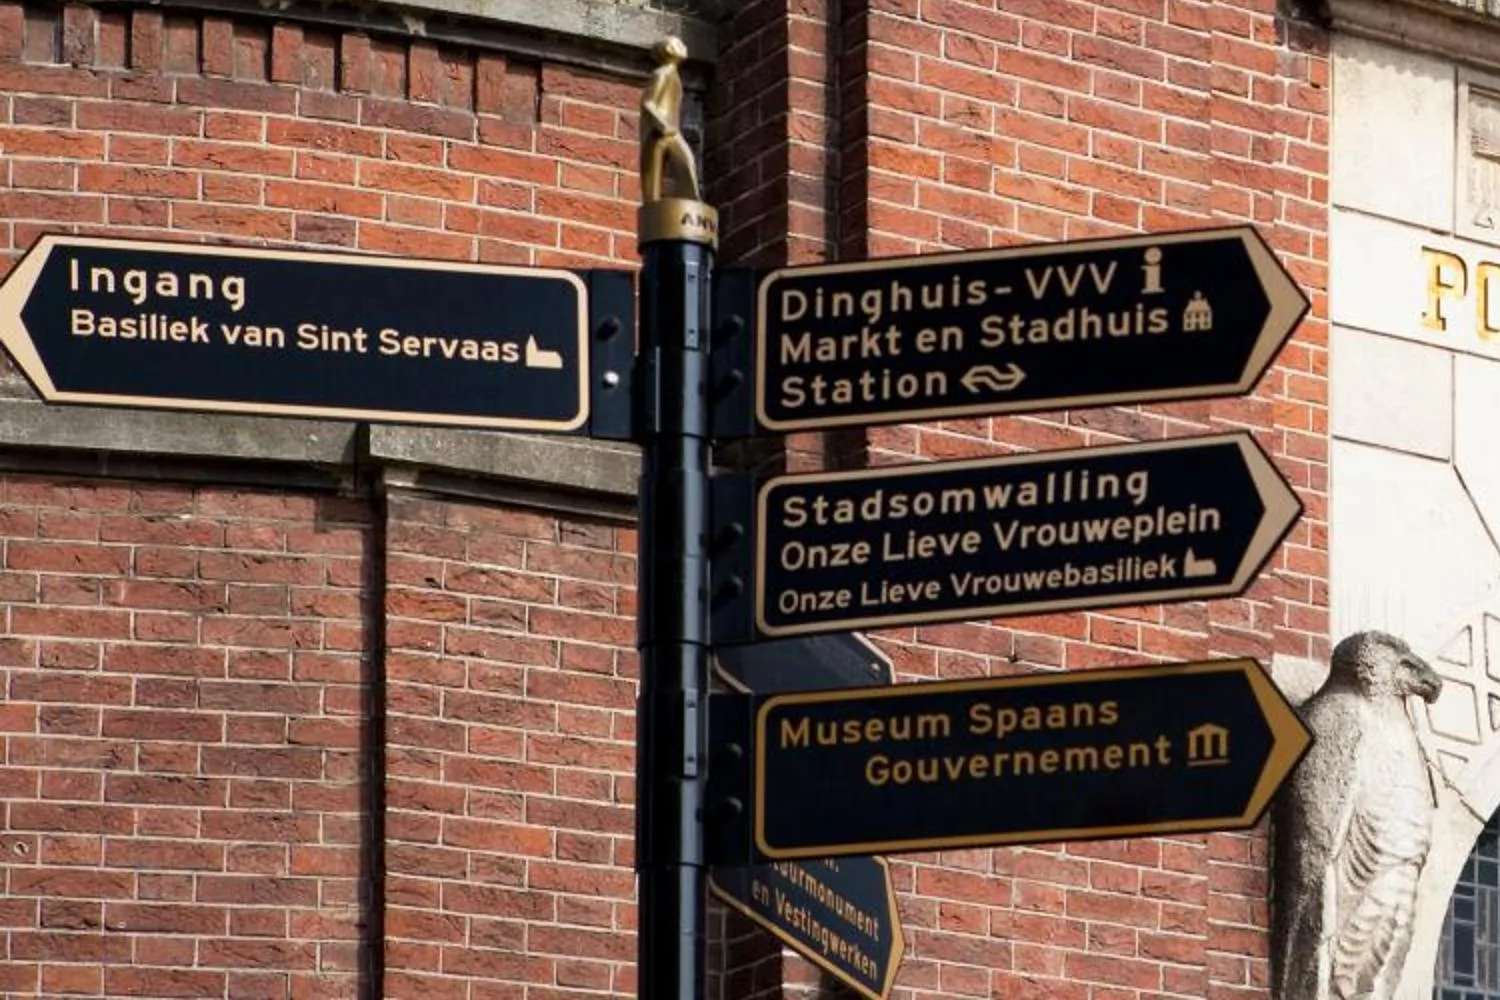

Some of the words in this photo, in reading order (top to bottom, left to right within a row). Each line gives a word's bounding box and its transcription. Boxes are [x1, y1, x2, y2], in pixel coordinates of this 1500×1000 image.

[71, 259, 244, 311] Ingang
[1026, 262, 1117, 299] VVV
[72, 310, 209, 342] Basiliek
[221, 325, 284, 347] van
[298, 324, 367, 352] Sint
[380, 329, 519, 362] Servaas
[782, 326, 901, 364] Markt
[915, 327, 963, 353] en
[981, 304, 1168, 347] Stadhuis
[782, 369, 946, 407] Station
[784, 470, 1147, 527] Stadsomwalling
[782, 542, 870, 570] Onze
[884, 531, 981, 560] Lieve
[994, 504, 1219, 550] Vrouweplein
[780, 590, 851, 613] Onze
[862, 581, 940, 605] Lieve
[951, 554, 1175, 596] Vrouwebasiliek
[781, 714, 950, 747] Museum
[970, 701, 1118, 741] Spaans
[866, 736, 1170, 785] Gouvernement
[752, 878, 769, 907] en
[775, 887, 877, 982] Vestingwerken
